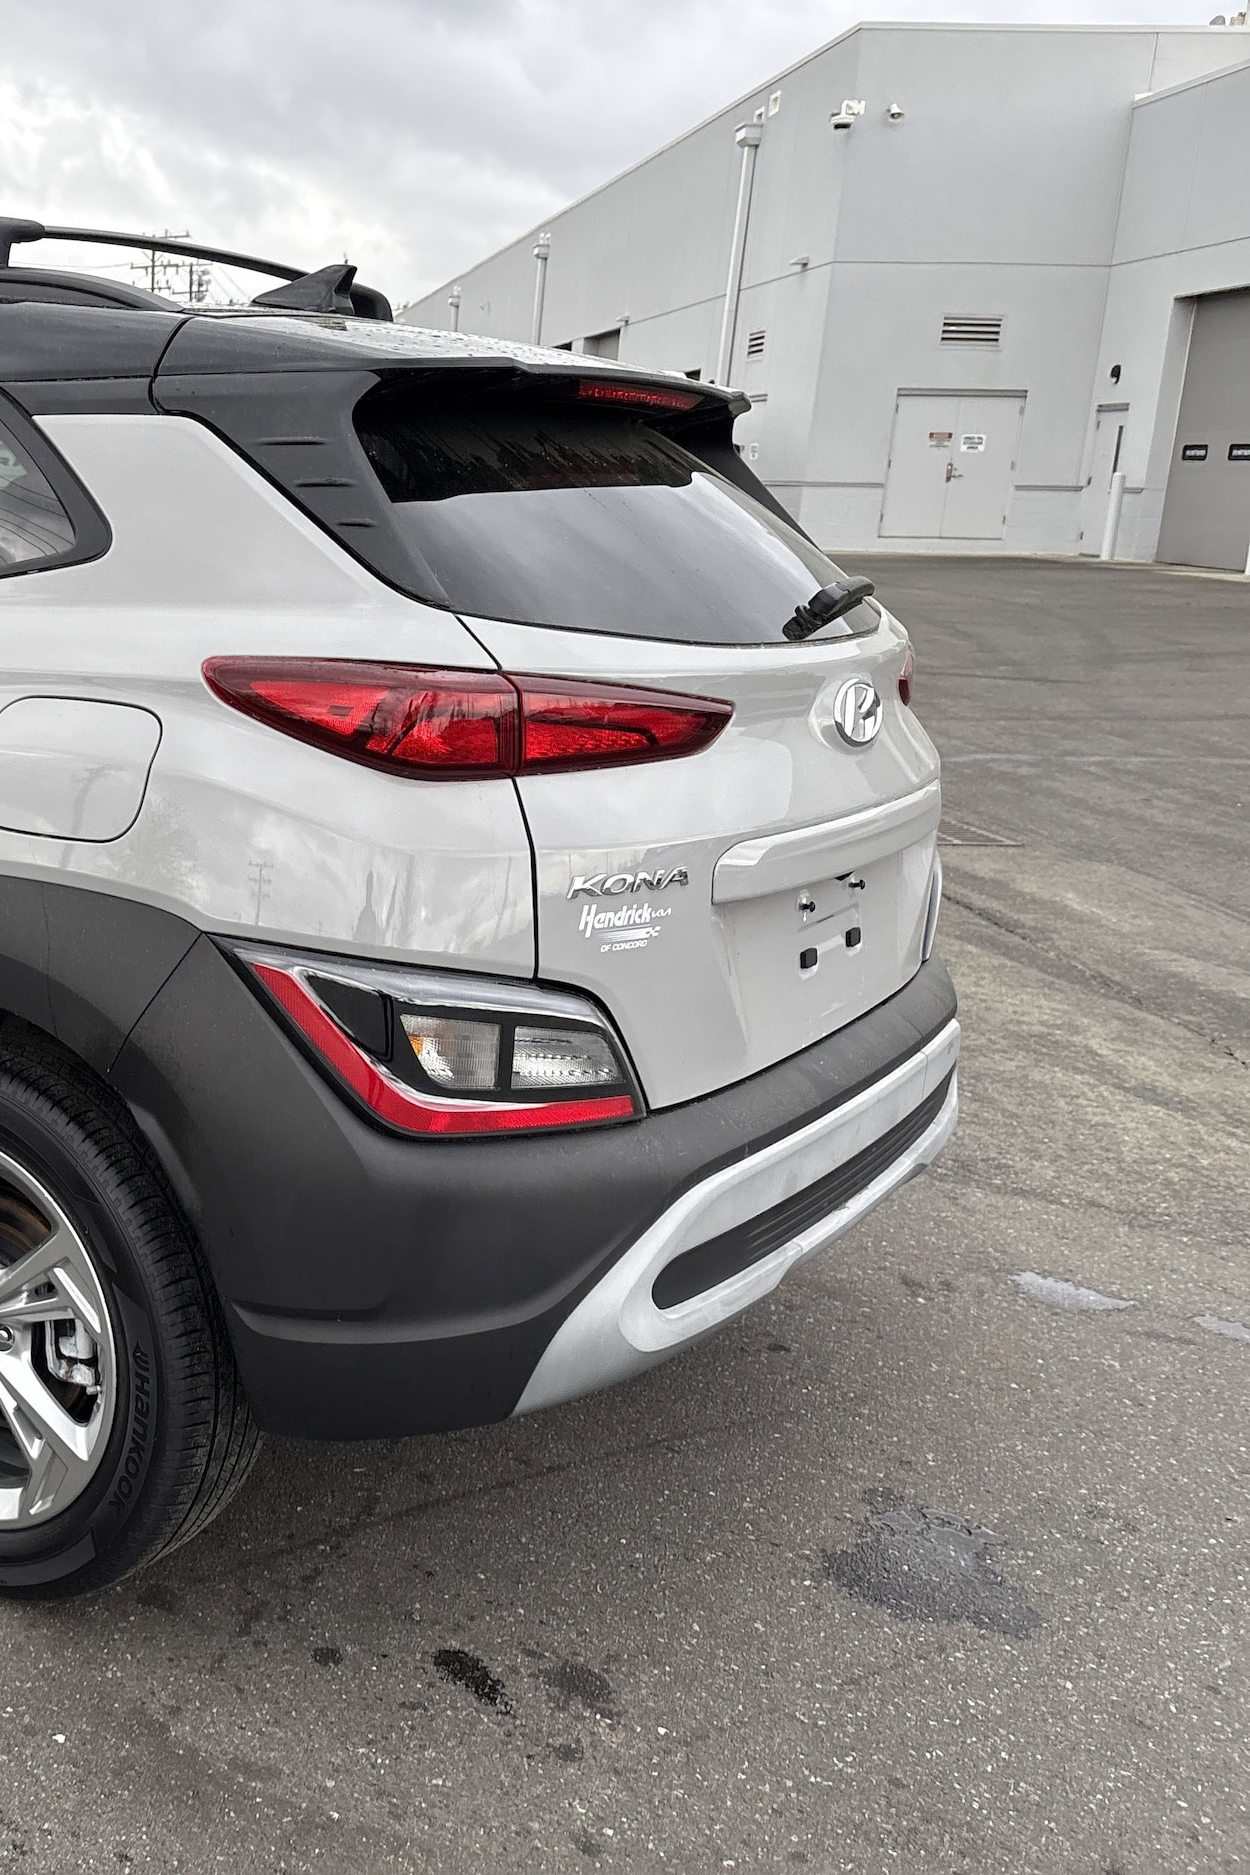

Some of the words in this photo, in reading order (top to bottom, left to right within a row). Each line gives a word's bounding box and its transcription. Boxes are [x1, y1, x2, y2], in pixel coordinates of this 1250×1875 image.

[566, 866, 689, 900] KONA
[578, 902, 652, 938] Hendrick
[600, 944, 611, 953] OF
[612, 939, 648, 951] CONCORD
